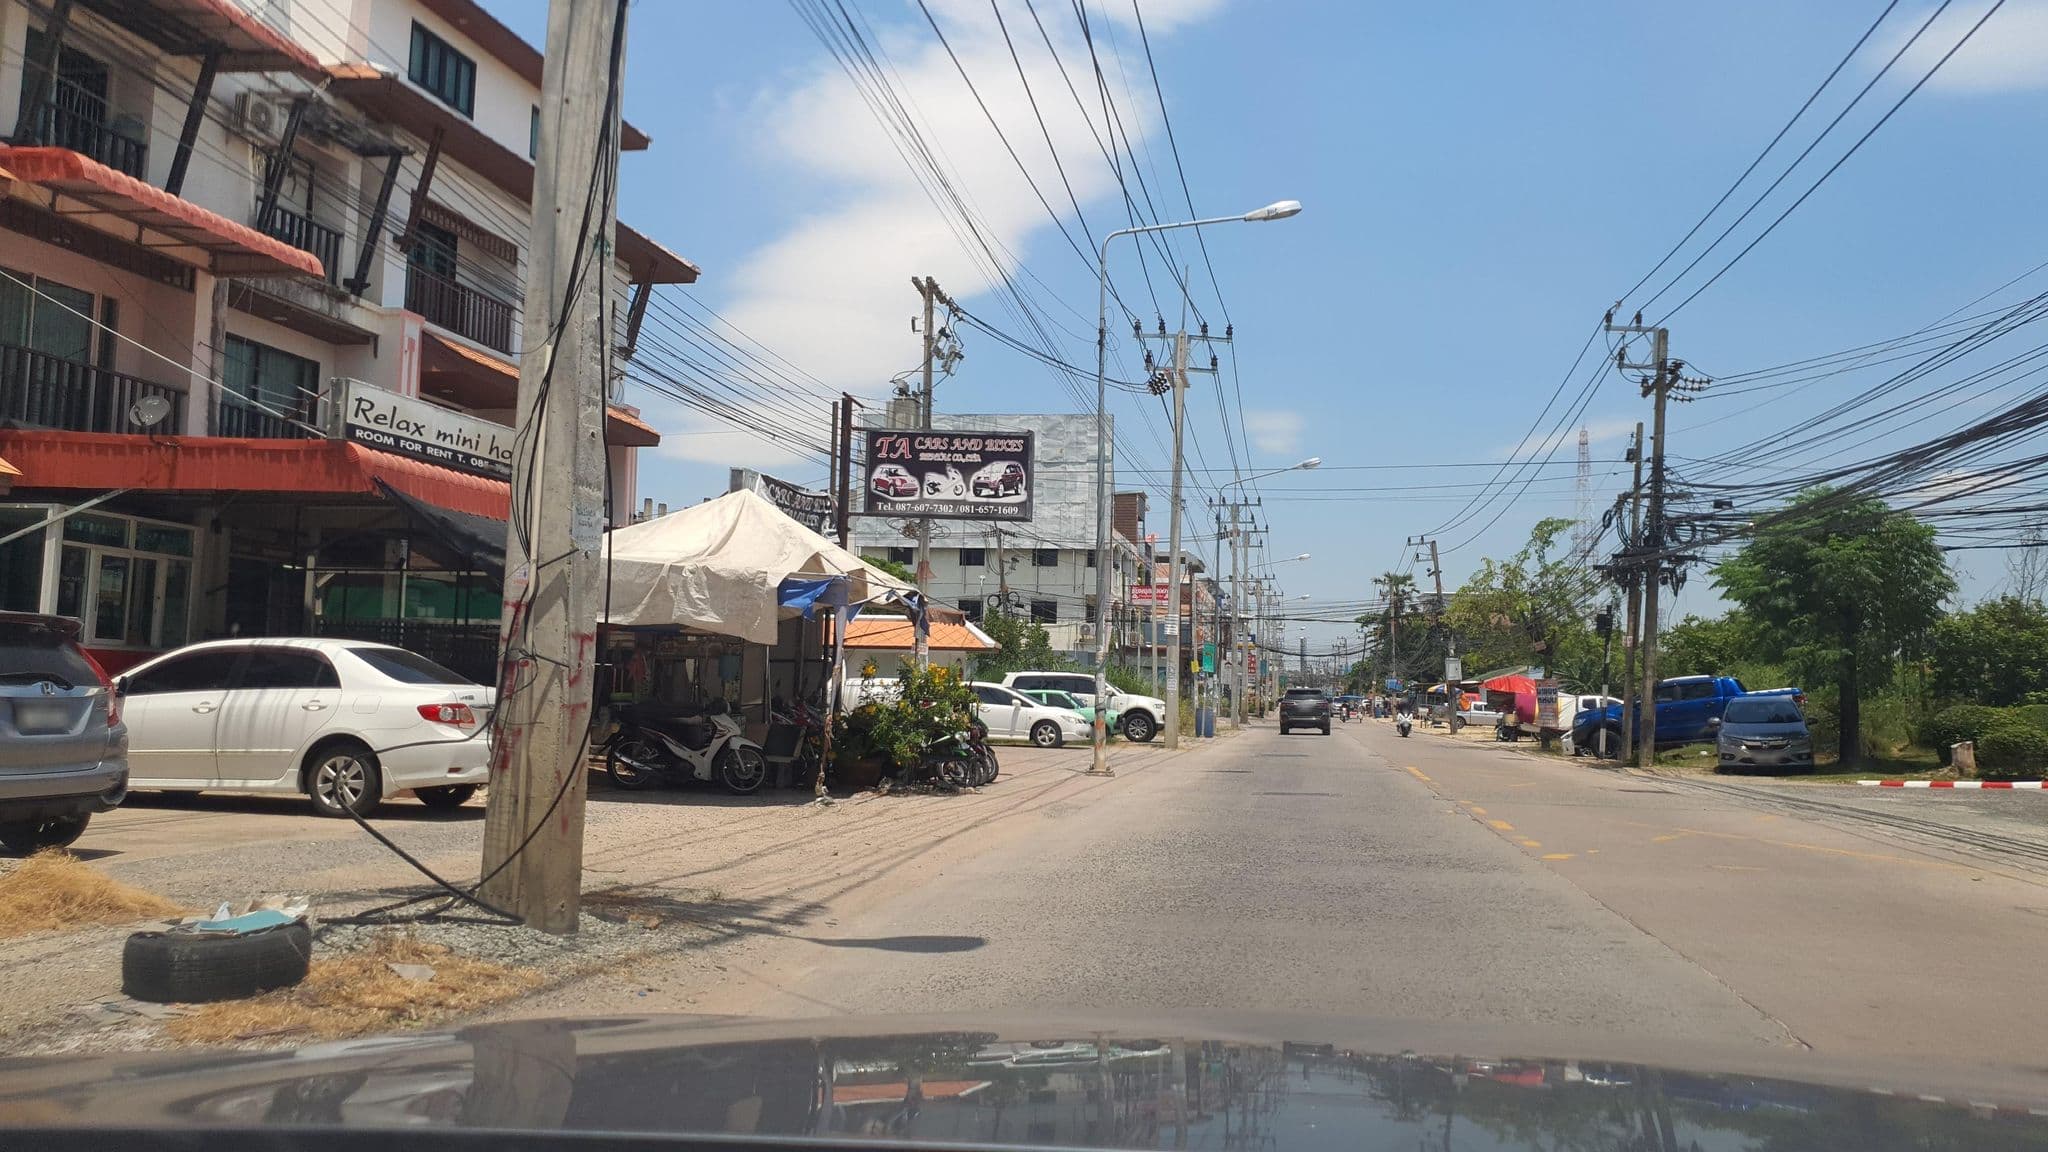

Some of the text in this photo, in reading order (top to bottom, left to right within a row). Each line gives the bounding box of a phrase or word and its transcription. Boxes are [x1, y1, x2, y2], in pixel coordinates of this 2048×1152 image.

[355, 397, 425, 437] Relax
[436, 428, 481, 451] mini
[355, 428, 466, 464] ROOM FOR RENT T.
[914, 437, 949, 451] CARS
[951, 438, 983, 451] AND
[985, 440, 1024, 452] BIKES
[896, 502, 954, 513] 087-607-7302
